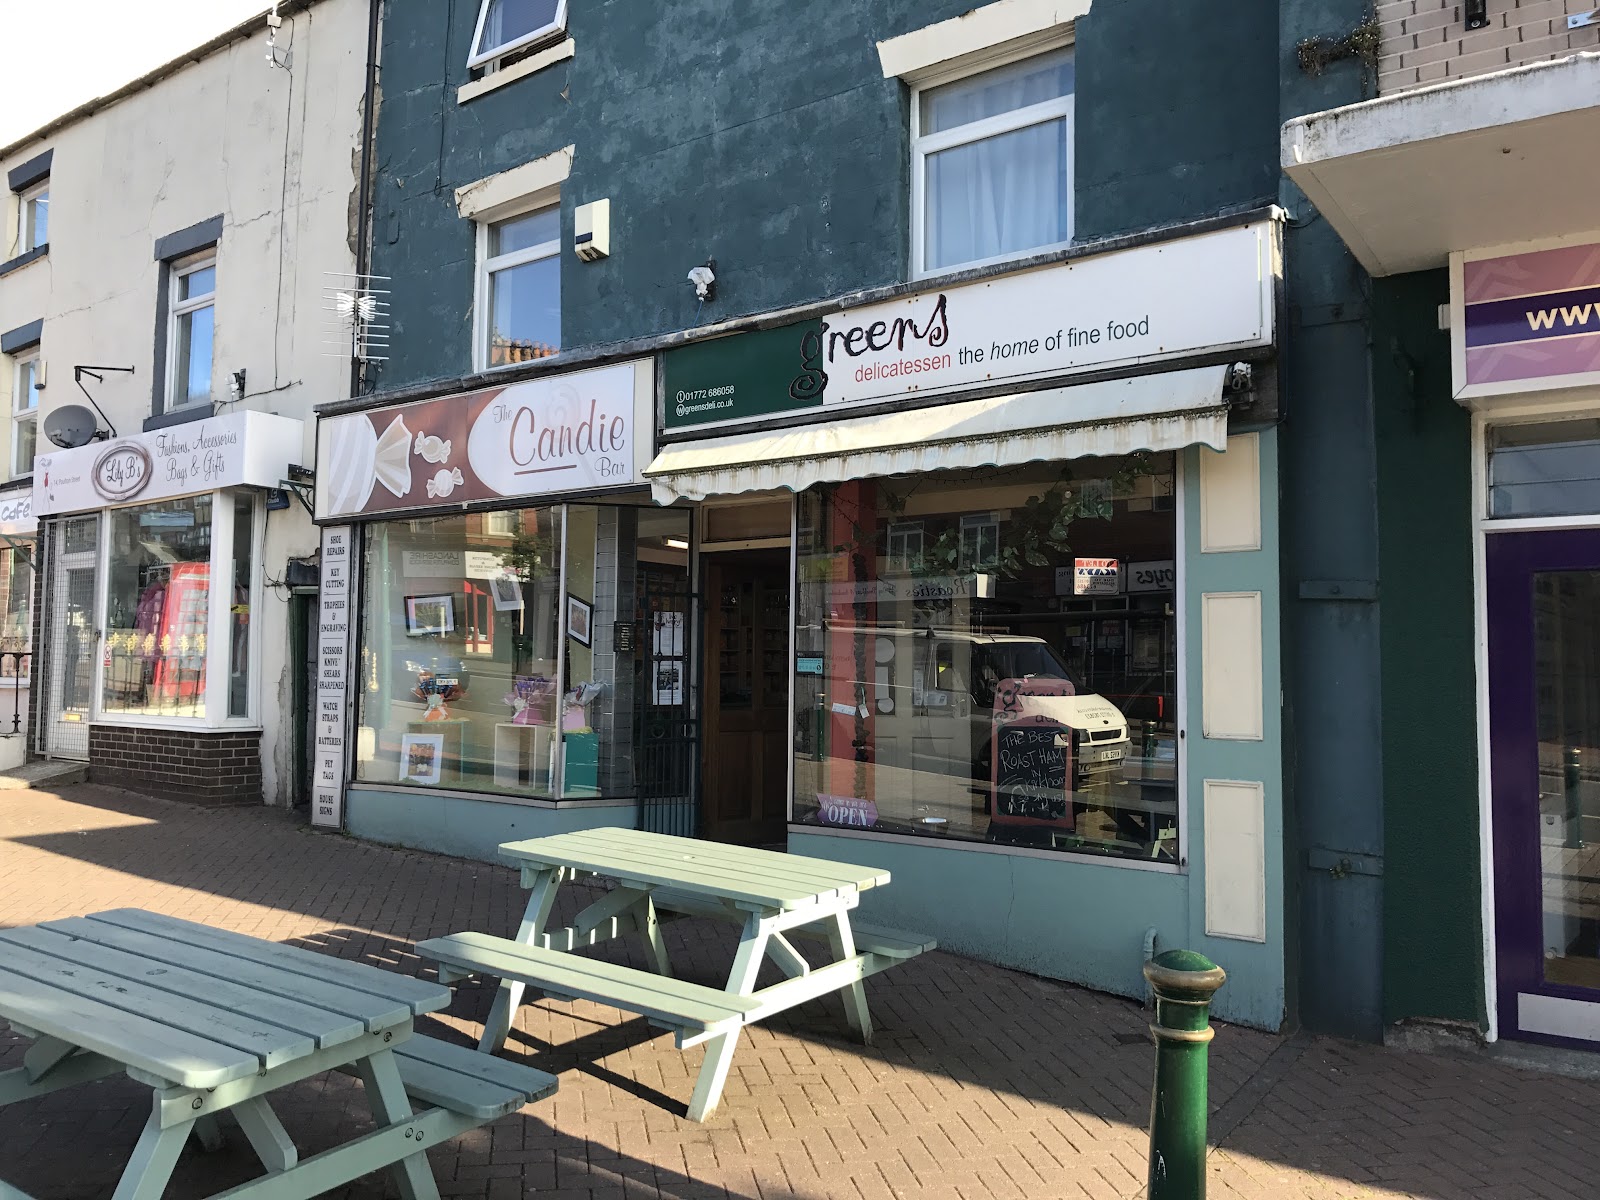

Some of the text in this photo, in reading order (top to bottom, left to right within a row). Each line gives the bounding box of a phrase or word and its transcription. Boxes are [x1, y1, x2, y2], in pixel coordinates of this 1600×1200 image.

[1526, 302, 1600, 331] ww
[789, 293, 949, 401] greens
[855, 315, 1149, 383] delicatessen the home of fine food
[685, 389, 707, 401] 01772
[708, 385, 735, 397] 686058
[493, 404, 513, 424] The
[193, 425, 237, 450] Accessories
[509, 399, 625, 467] Candie
[105, 455, 141, 487] Lily B's
[166, 449, 225, 487] Bags & Gifts
[594, 456, 626, 477] Bar
[330, 536, 342, 544] SHOE
[326, 546, 345, 556] REPAIRS
[330, 568, 341, 577] KEY
[326, 580, 345, 588] CUTTING
[324, 600, 345, 610] TROPHIES
[320, 624, 347, 632] ENGRAVING
[322, 646, 343, 655] SCISSORS
[324, 658, 341, 667] KNIVE
[323, 670, 341, 678] SHEARS
[318, 681, 345, 690] SHARPENED
[322, 702, 338, 711] WATCH
[322, 714, 339, 722] STRAPS
[318, 736, 342, 746] BATTERIES
[1002, 730, 1060, 749] THE BEST
[324, 760, 334, 768] PET
[1000, 748, 1065, 773] ROAST HAM
[322, 771, 334, 780] TAGS
[319, 794, 334, 804] HOUSE
[319, 806, 333, 816] SIGNS
[828, 805, 869, 826] OPEN
